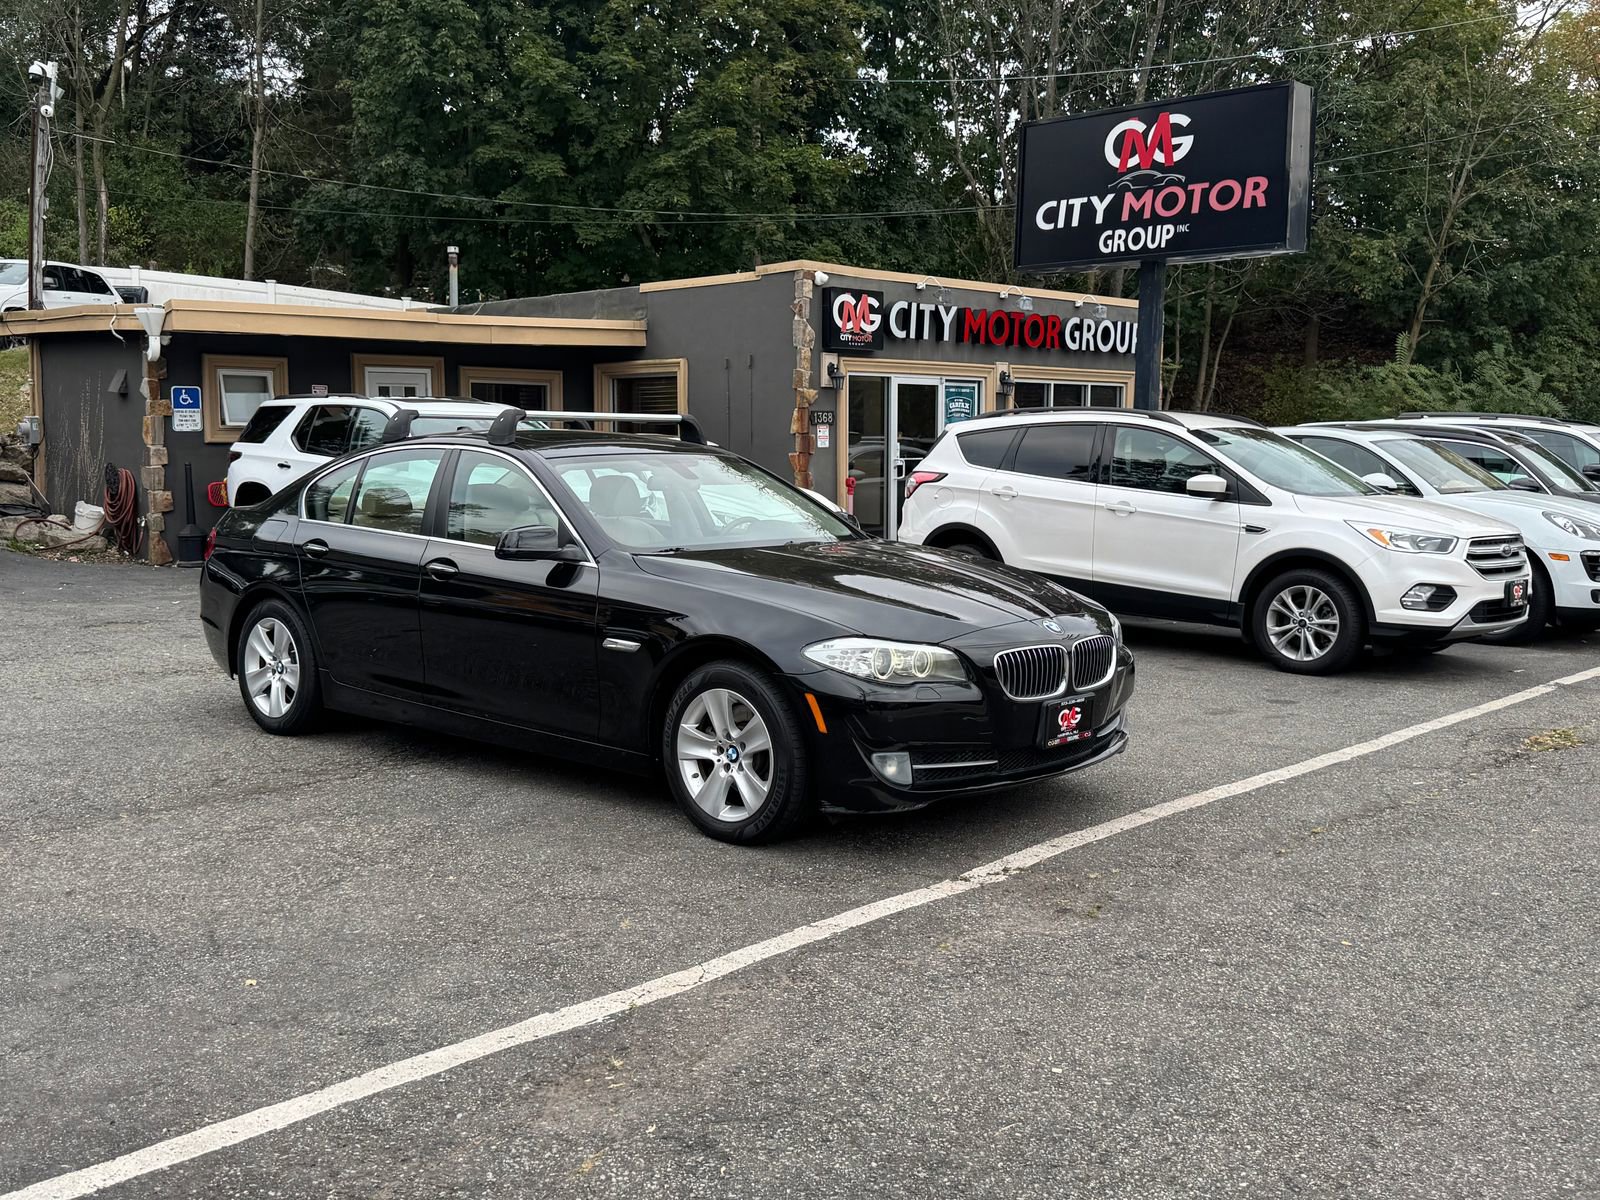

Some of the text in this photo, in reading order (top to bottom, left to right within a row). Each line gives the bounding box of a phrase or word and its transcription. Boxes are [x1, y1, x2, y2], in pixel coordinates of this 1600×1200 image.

[1035, 176, 1270, 231] CITY MOTOR
[1098, 223, 1190, 254] GROUP INC
[889, 300, 958, 342] CITY
[963, 307, 1062, 350] MOTOR
[814, 412, 833, 423] 1368
